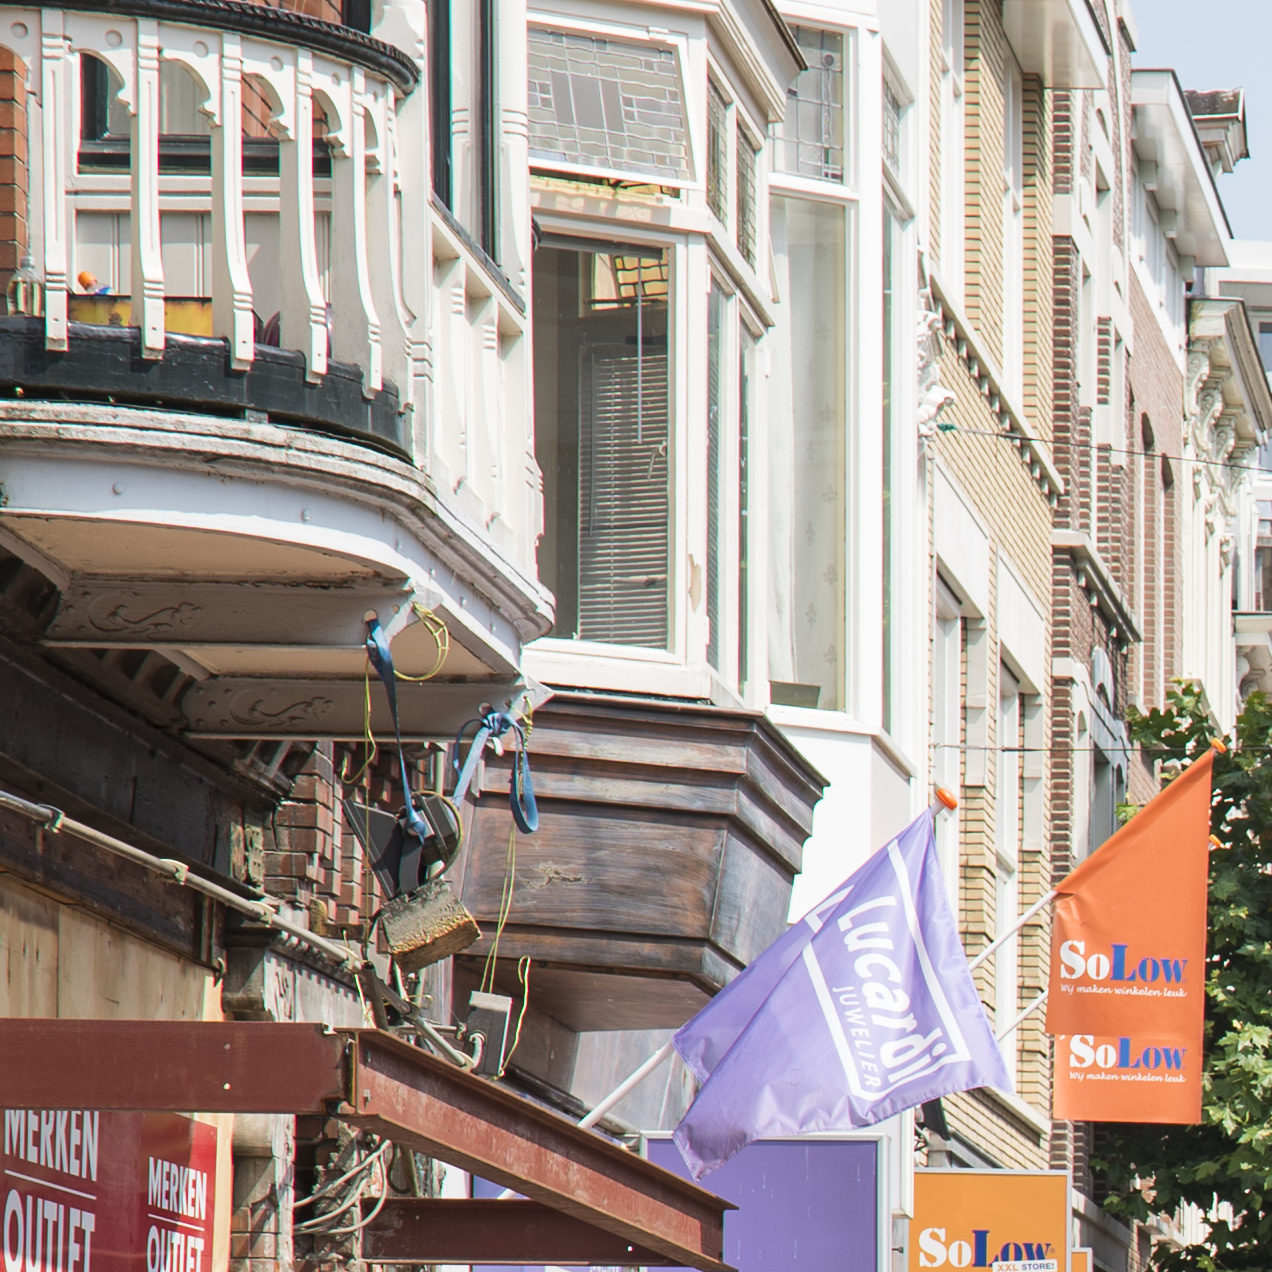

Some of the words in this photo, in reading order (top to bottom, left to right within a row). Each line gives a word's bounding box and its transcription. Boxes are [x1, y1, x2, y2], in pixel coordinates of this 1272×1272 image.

[837, 895, 948, 1083] Lucardi
[832, 986, 882, 1089] JUWELIER
[4, 1110, 99, 1182] MERKEN
[148, 1156, 207, 1221] MERKEN
[996, 1264, 1019, 1272] XXL
[1021, 1262, 1055, 1271] STORE!
